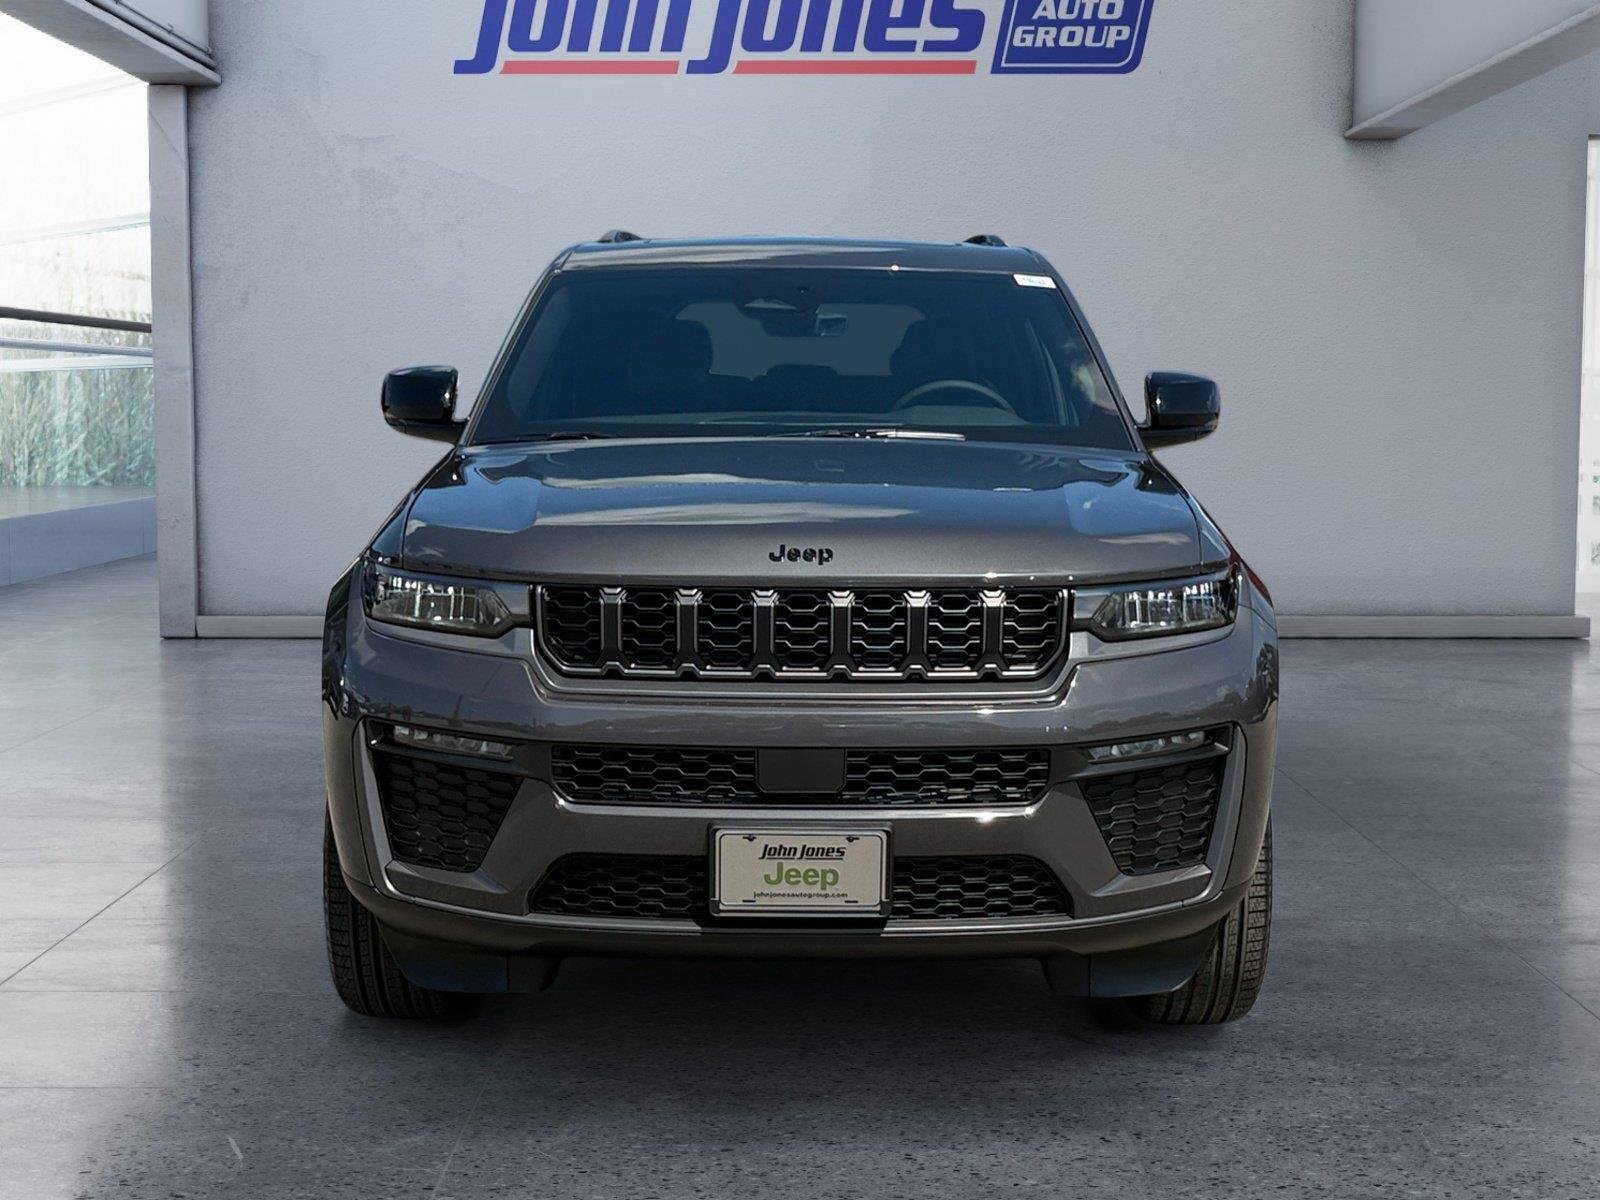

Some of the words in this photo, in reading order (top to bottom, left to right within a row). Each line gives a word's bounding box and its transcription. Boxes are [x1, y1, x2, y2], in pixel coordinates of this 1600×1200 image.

[1032, 0, 1124, 20] AUTO
[1012, 25, 1131, 48] GROUP
[768, 544, 834, 566] Jeep
[758, 844, 798, 860] John
[797, 844, 847, 860] Jones
[763, 861, 840, 891] Jeep
[753, 890, 848, 899] johnjonesautogroup.com
